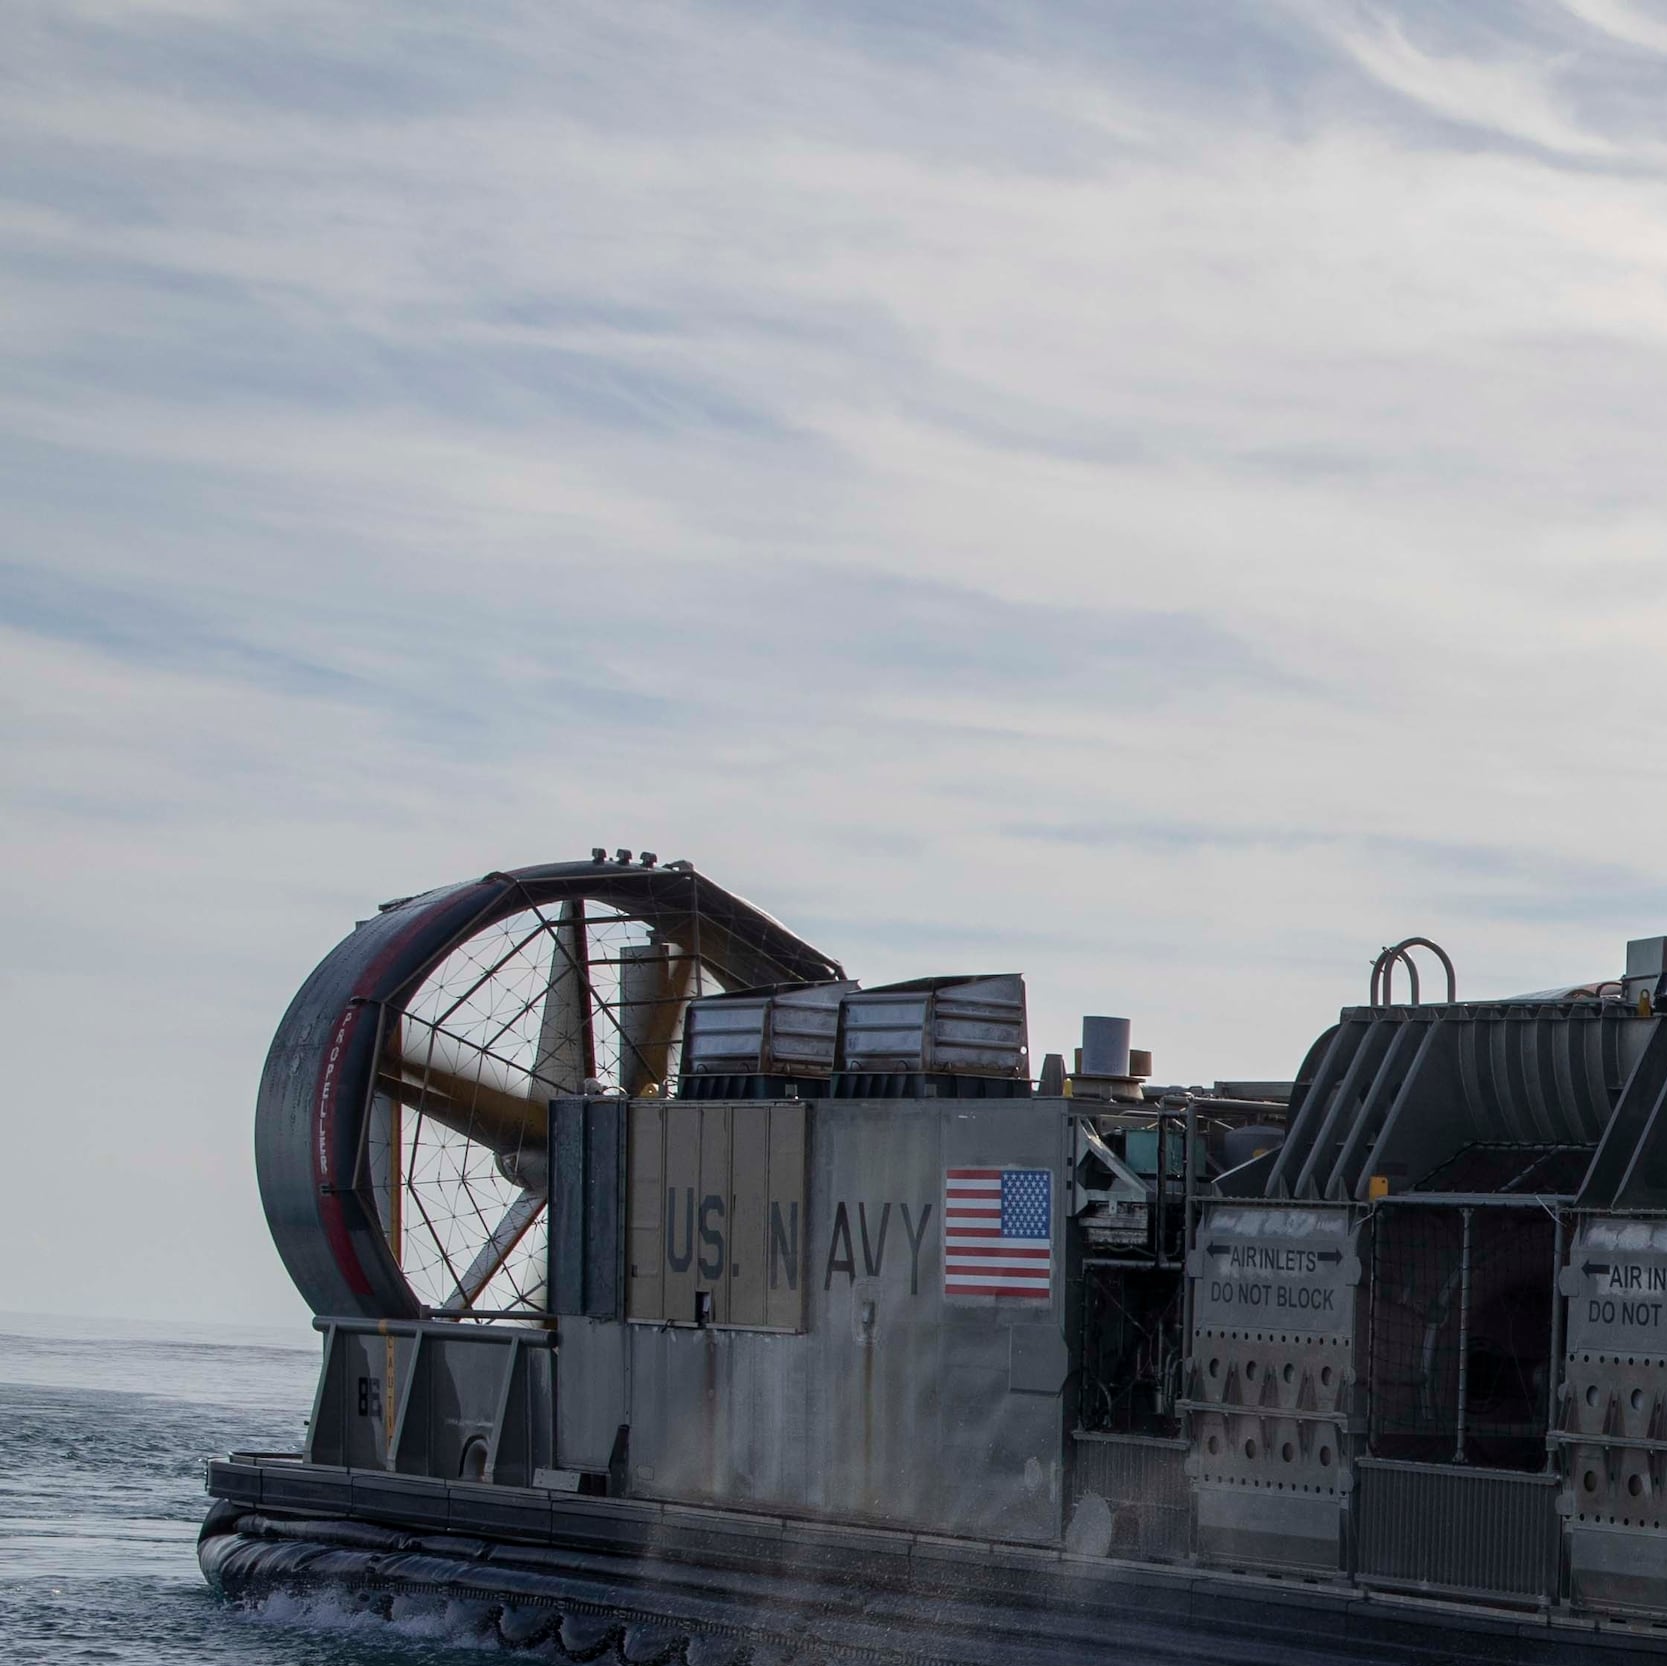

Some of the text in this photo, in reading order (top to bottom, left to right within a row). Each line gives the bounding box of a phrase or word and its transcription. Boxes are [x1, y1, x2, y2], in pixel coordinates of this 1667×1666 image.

[319, 1012, 352, 1175] PROPELLER
[770, 1200, 932, 1295] NAVY
[1231, 1246, 1316, 1272] AIR INLETS
[1610, 1265, 1642, 1289] AIR
[1211, 1281, 1335, 1311] DO NOT BLOCK
[1588, 1300, 1615, 1324] DO
[1622, 1302, 1663, 1327] NOT
